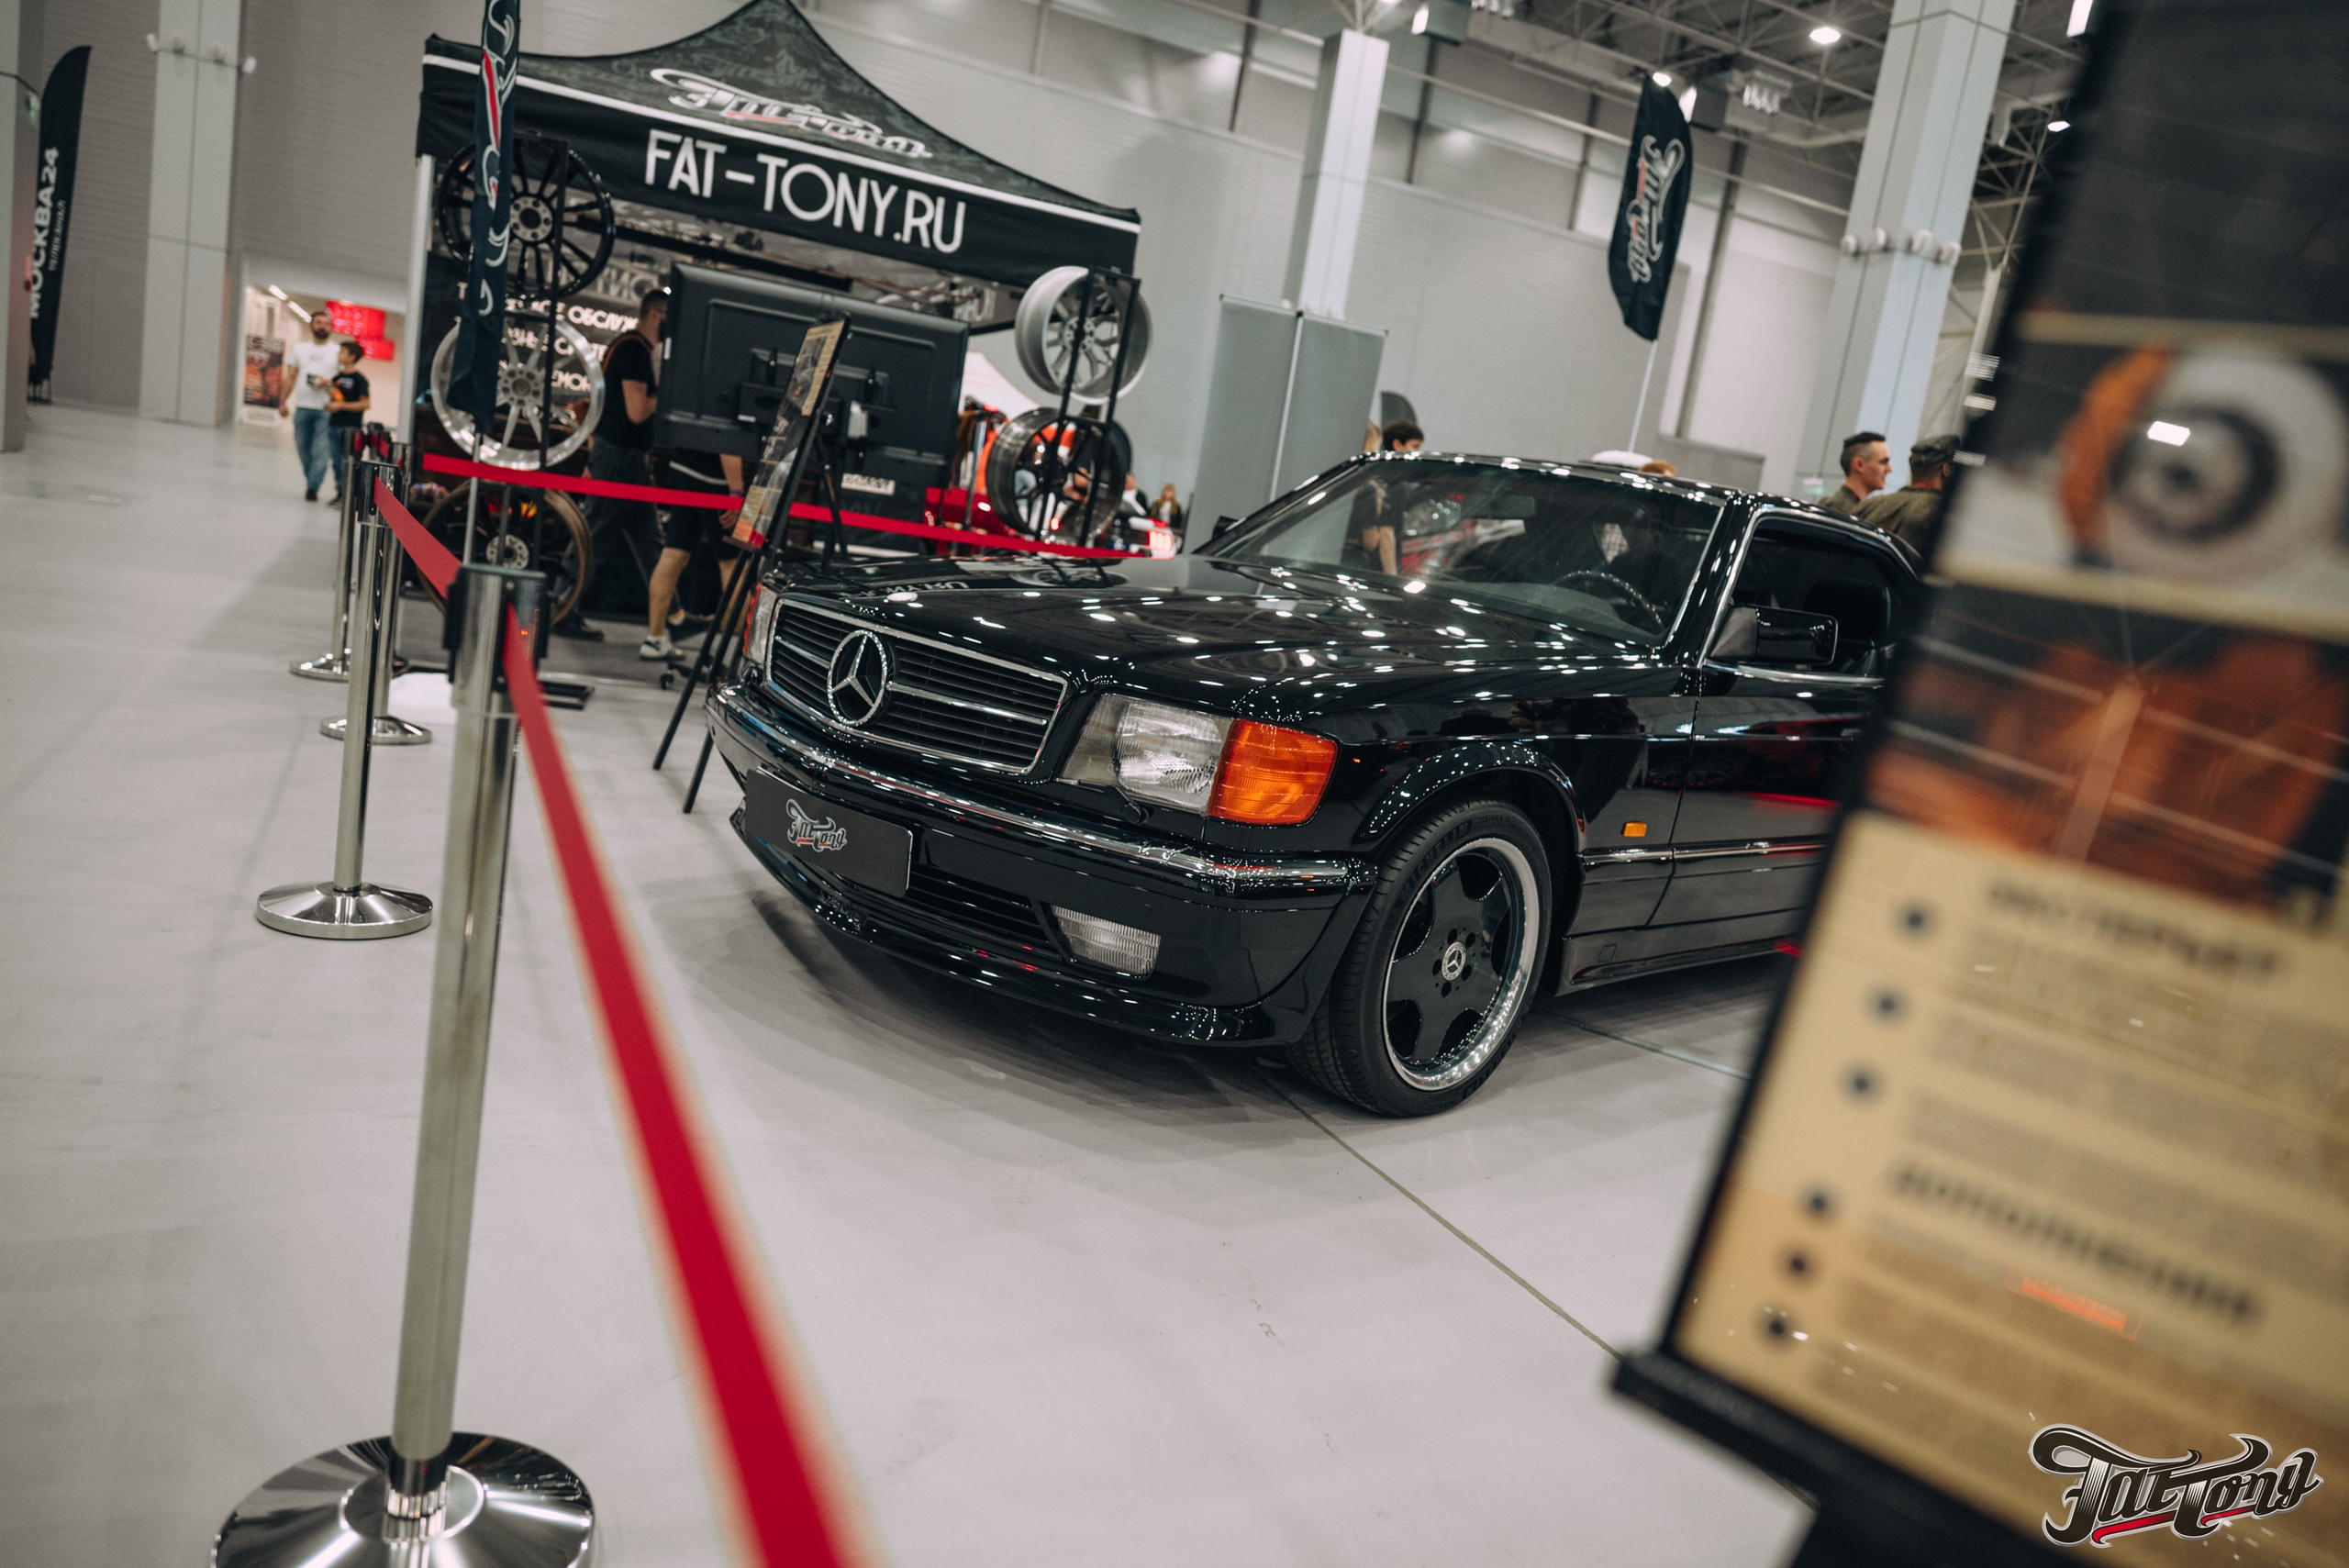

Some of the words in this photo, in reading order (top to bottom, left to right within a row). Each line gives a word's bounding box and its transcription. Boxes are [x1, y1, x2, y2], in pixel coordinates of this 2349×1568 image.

[30, 148, 59, 318] МОСКВА24
[645, 128, 965, 253] FAT-TONY.RU
[568, 306, 639, 333] ОБСЛУЖ
